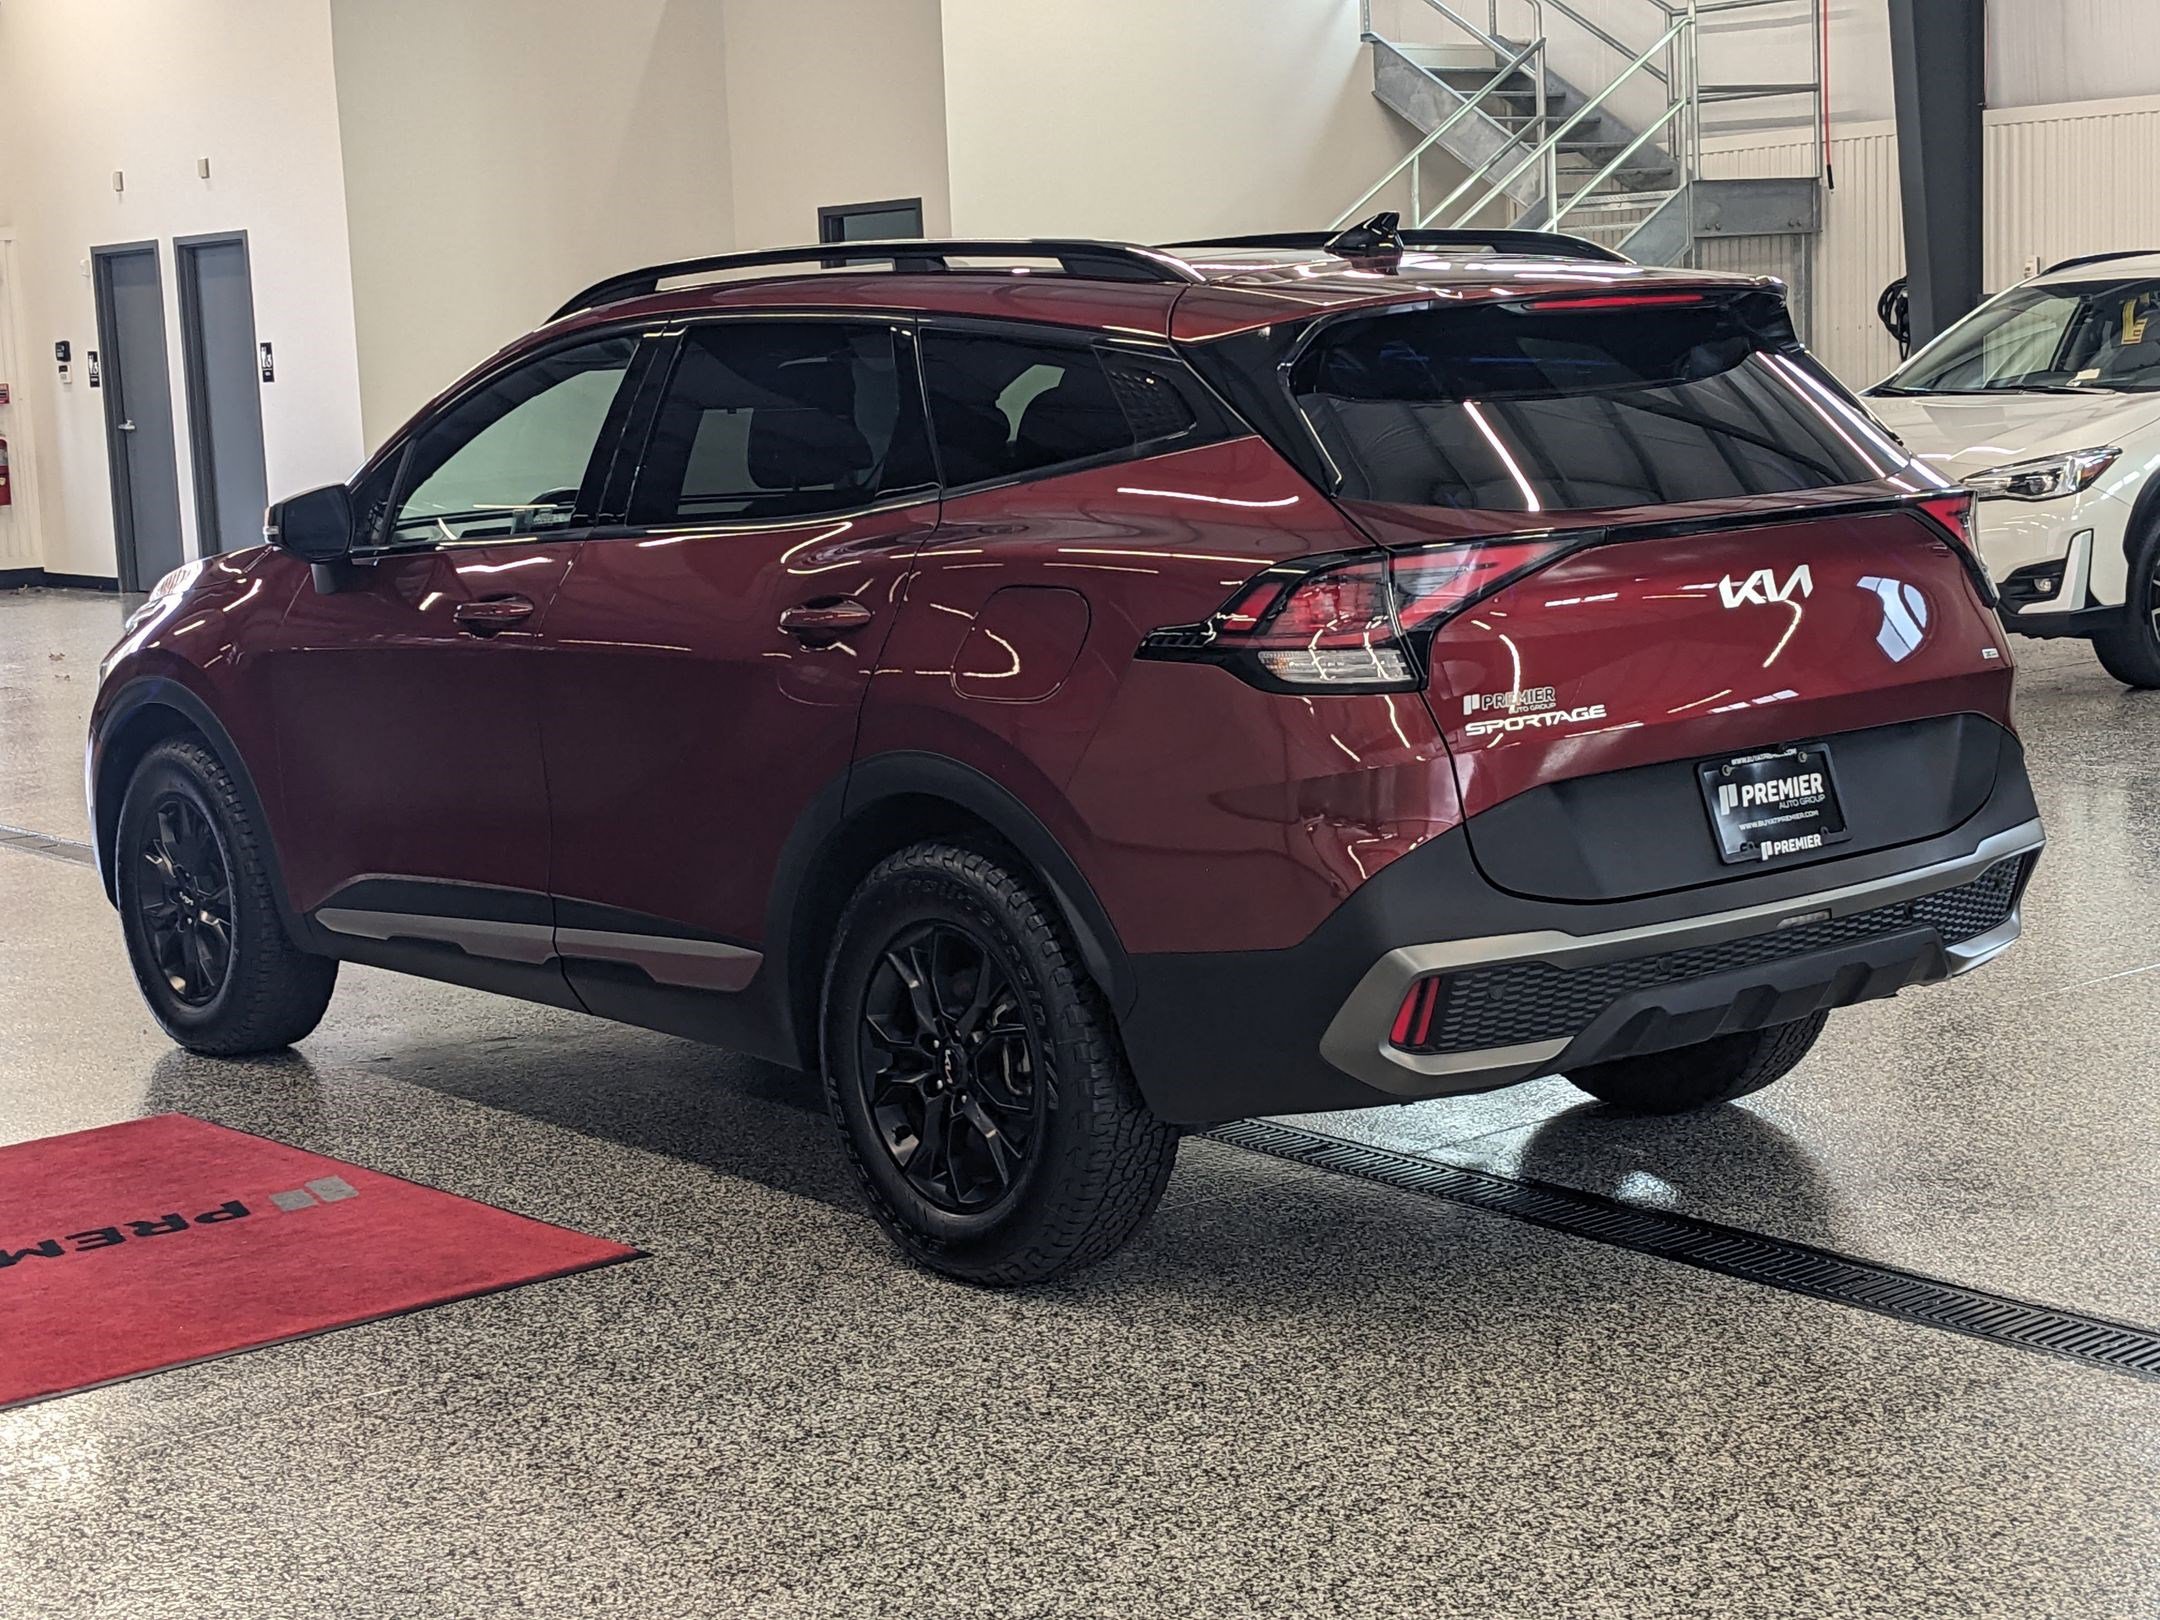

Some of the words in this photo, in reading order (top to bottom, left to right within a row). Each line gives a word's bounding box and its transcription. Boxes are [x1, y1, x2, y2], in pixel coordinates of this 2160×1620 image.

[1719, 564, 1813, 608] KIA
[1482, 687, 1556, 710] PREMIER
[1530, 702, 1556, 712] GROUP
[1465, 704, 1607, 736] SPORTAGE
[1741, 773, 1824, 807] PREMIER
[1779, 800, 1799, 810] AUTO
[1800, 794, 1826, 805] GROUP
[1774, 834, 1822, 855] PREMIER
